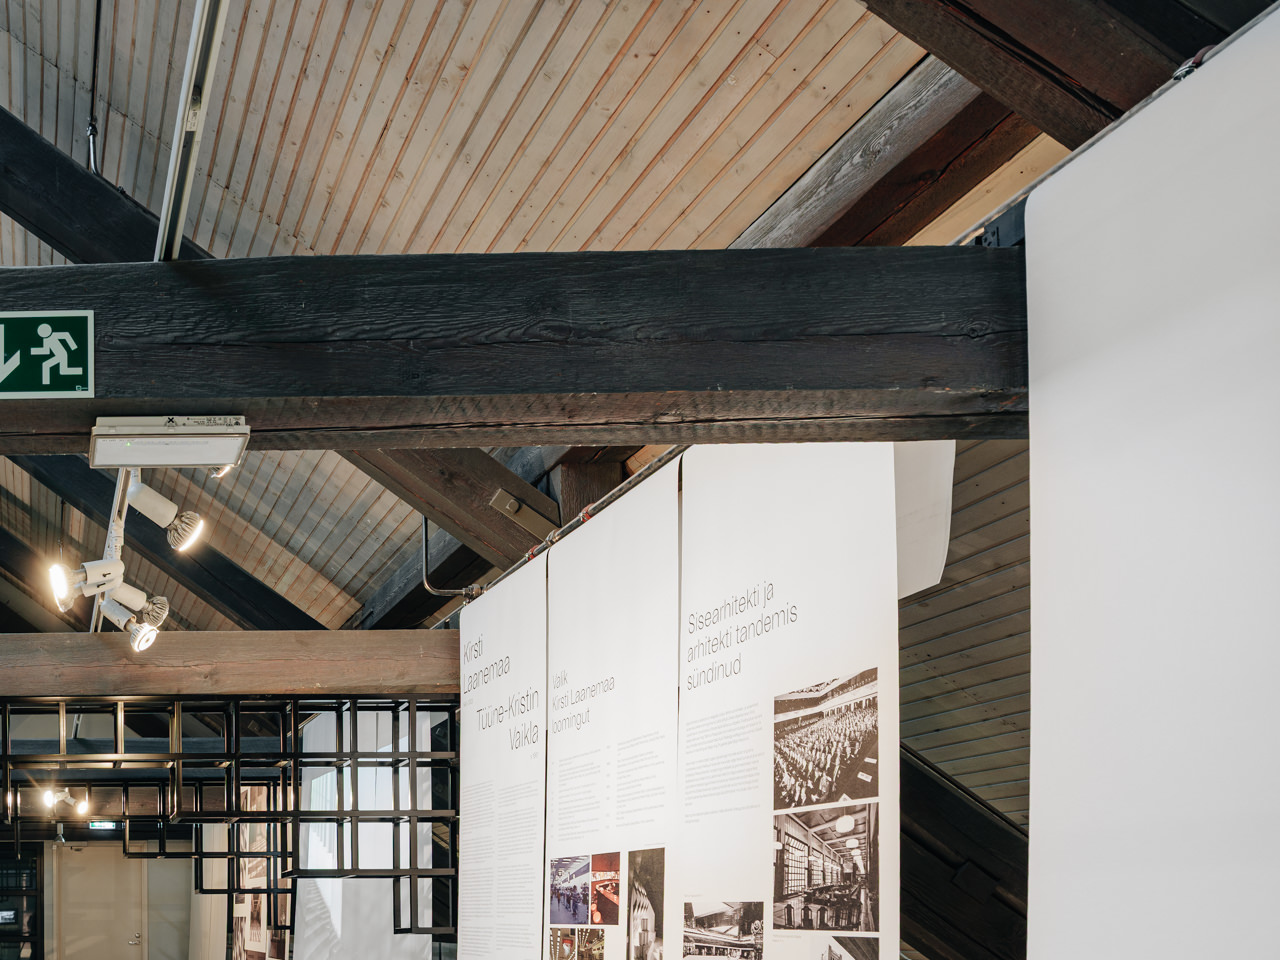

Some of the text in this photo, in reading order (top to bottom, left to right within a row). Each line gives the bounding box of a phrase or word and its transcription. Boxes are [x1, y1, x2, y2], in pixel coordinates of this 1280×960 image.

[688, 580, 774, 634] Sisearhitekti ja
[463, 633, 483, 665] Kirsti
[687, 602, 798, 663] arhitekti tandemis
[463, 655, 511, 695] Laanemaa
[552, 669, 568, 690] Valik
[687, 652, 741, 691] sündinud
[476, 686, 539, 731] Tüüne-Kristin
[552, 676, 615, 712] Kirsti Laanemaa
[508, 720, 539, 750] Vaikla
[551, 708, 591, 735] loomingut
